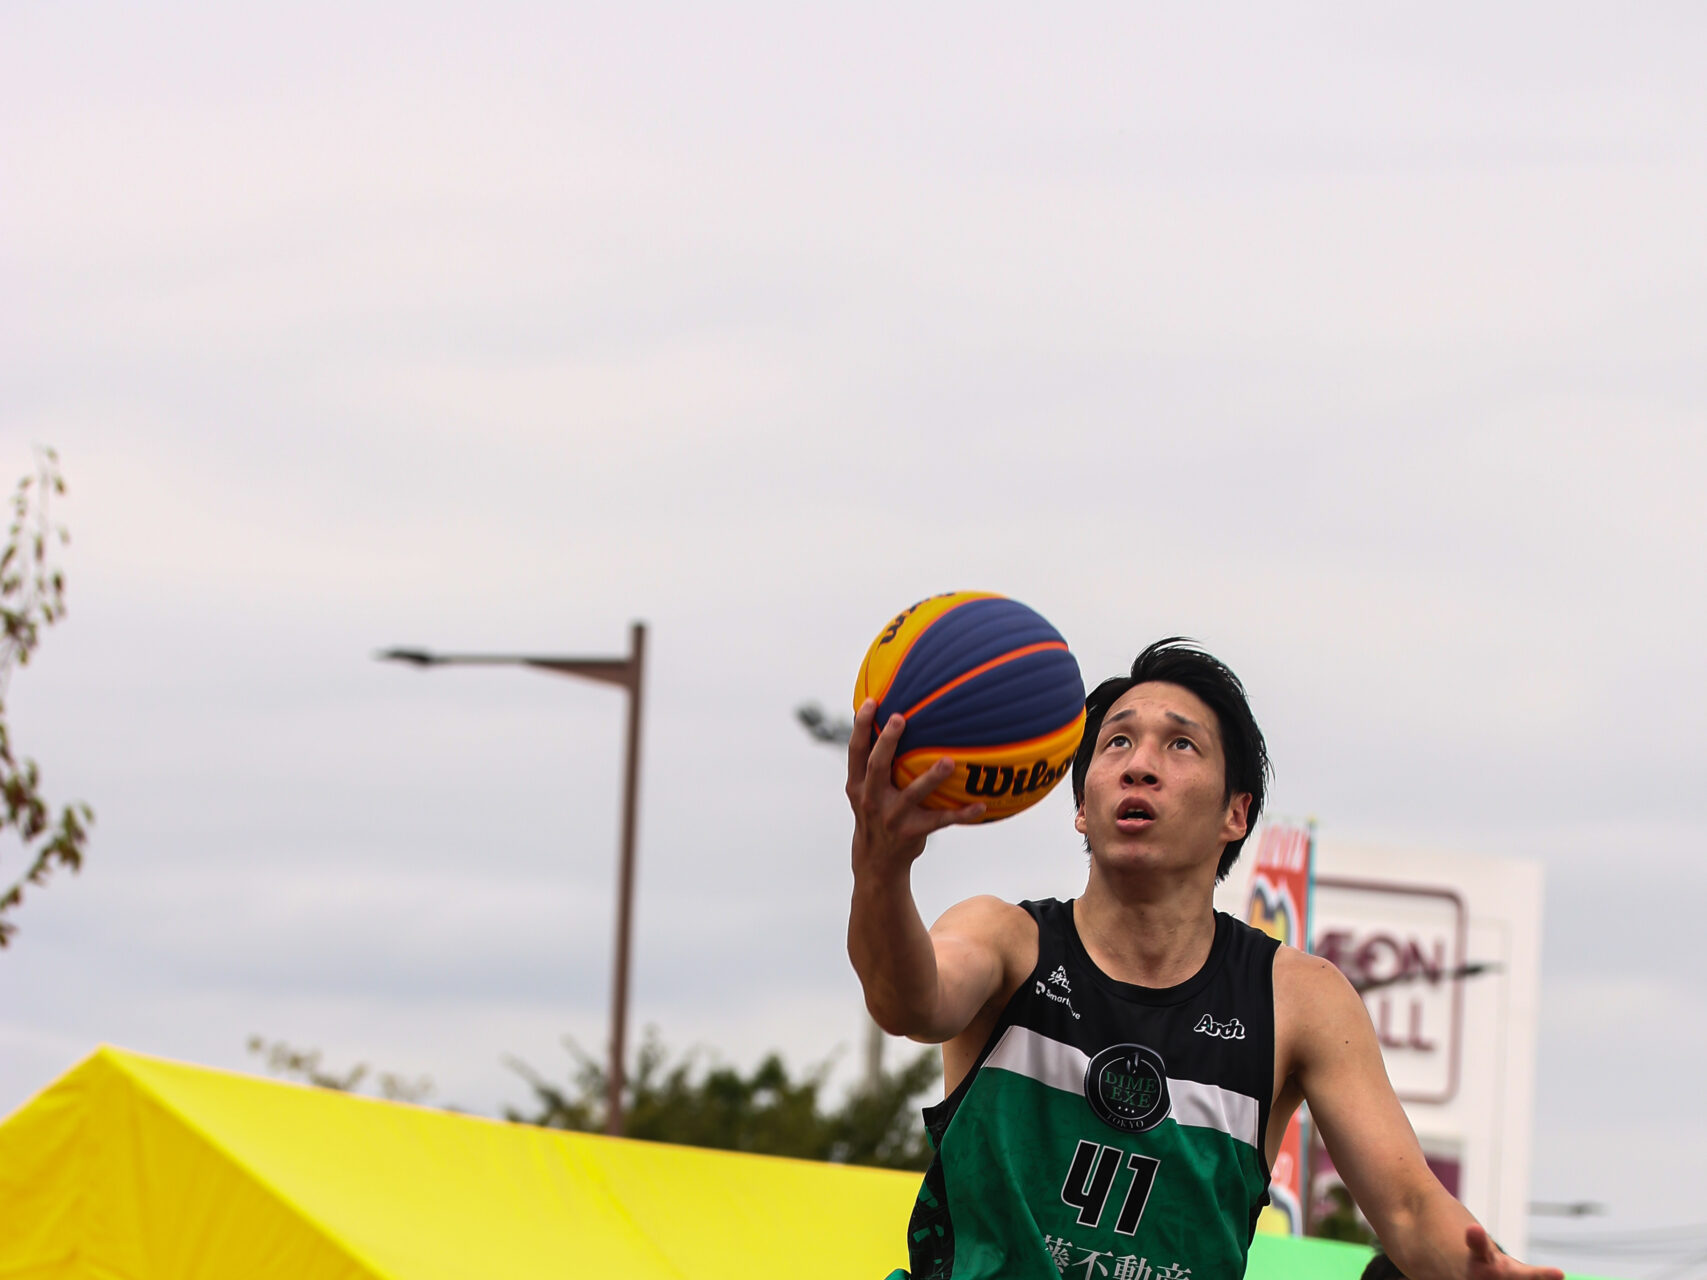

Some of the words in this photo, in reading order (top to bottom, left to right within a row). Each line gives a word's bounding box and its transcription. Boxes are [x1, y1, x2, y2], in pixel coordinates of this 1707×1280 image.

[1193, 1013, 1246, 1040] Arch
[1105, 1071, 1157, 1094] DIME
[1110, 1087, 1151, 1108] EXE
[1106, 1114, 1145, 1129] TOKYO
[1061, 1139, 1161, 1236] 41
